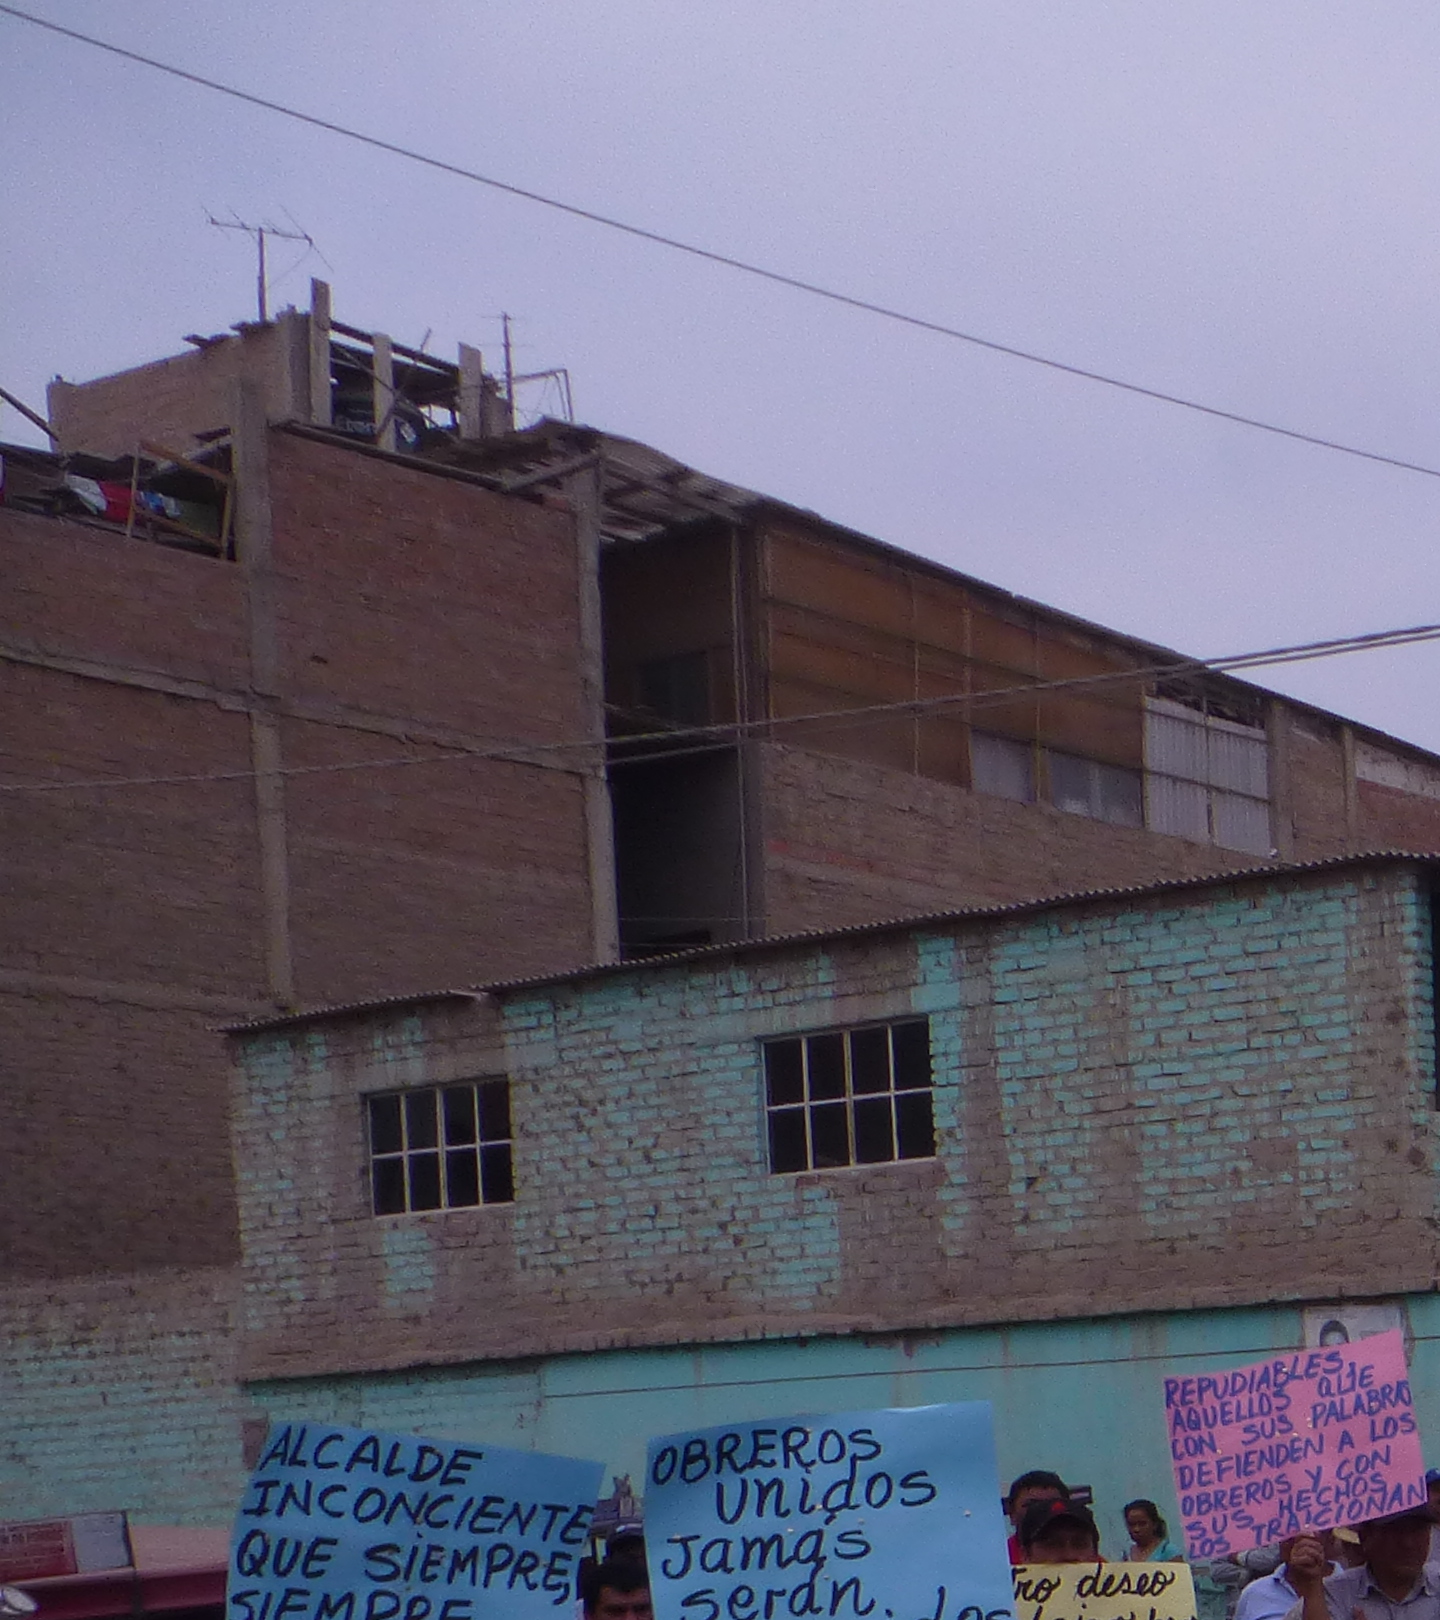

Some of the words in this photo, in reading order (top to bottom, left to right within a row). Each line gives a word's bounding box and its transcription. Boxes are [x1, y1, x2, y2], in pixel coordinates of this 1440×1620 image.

[1164, 1351, 1343, 1408] REPUDIABLES
[1172, 1386, 1291, 1435] AQUELLOS
[1318, 1362, 1374, 1397] QUE
[259, 1425, 483, 1485] ALCALDE
[652, 1427, 883, 1486] OBREROS
[1171, 1431, 1218, 1461] CON
[1241, 1414, 1293, 1446] SUS
[1178, 1433, 1324, 1490] DEFIENDEN
[1338, 1430, 1355, 1453] A
[1370, 1412, 1416, 1442] LOS
[243, 1479, 594, 1544] INCONCIENTE
[1181, 1473, 1292, 1517] OBREROS
[1304, 1466, 1322, 1493] Y
[1336, 1444, 1391, 1481] CON
[1185, 1509, 1254, 1541] SUS
[1279, 1472, 1386, 1518] HECHOS
[1188, 1535, 1230, 1559] LOS
[1252, 1476, 1425, 1545] TRAICIONAN
[236, 1529, 338, 1579] QUE
[1076, 1562, 1175, 1599] deseo
